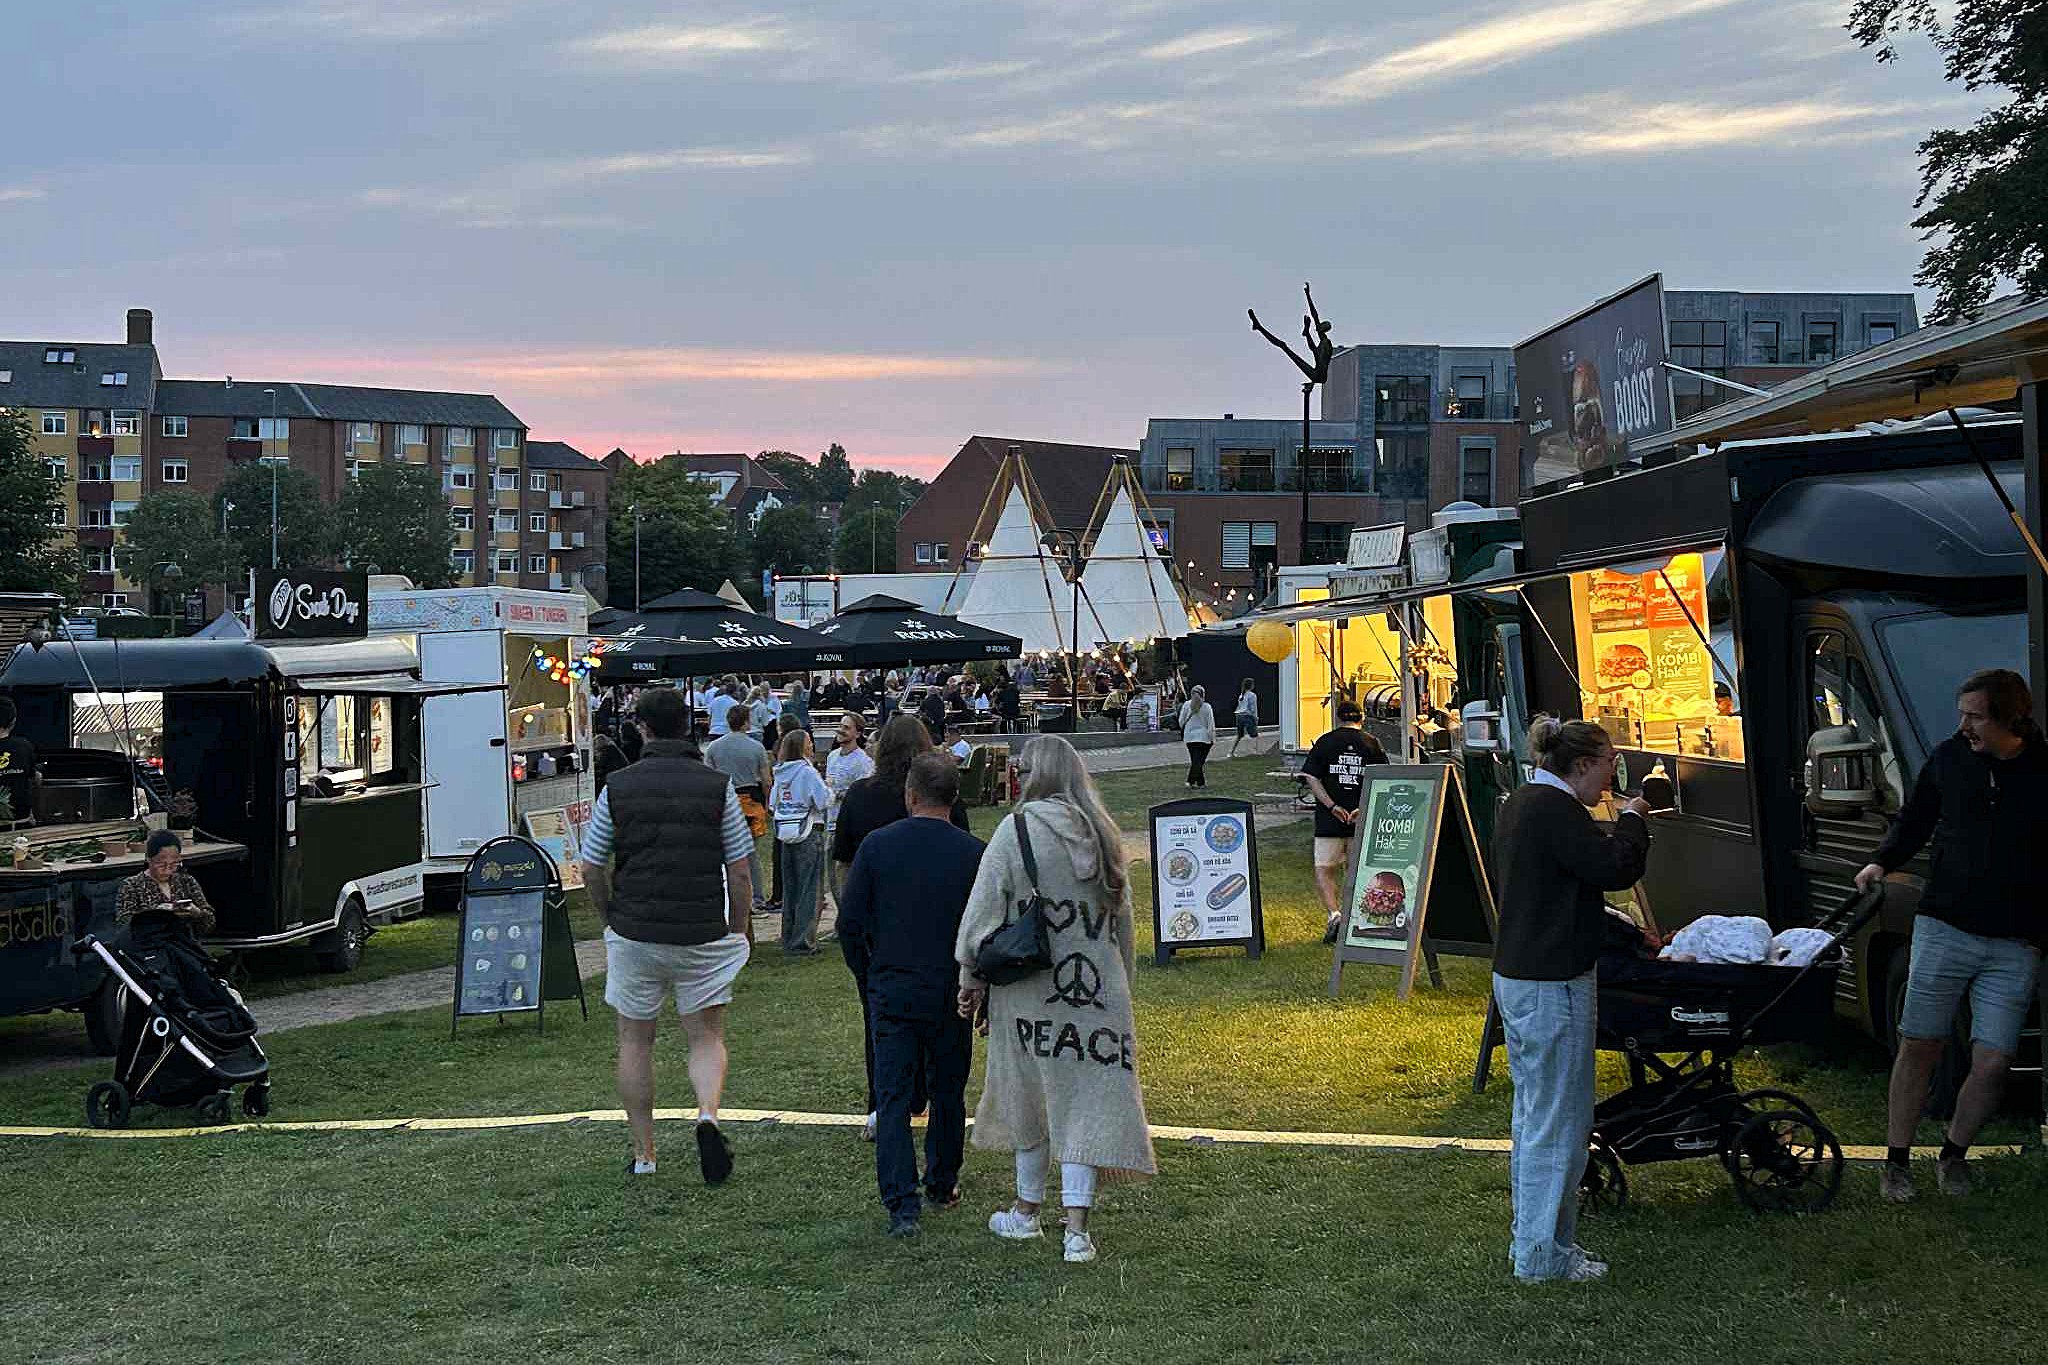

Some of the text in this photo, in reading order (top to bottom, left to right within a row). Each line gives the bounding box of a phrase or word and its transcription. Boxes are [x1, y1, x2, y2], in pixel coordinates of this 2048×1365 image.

[711, 634, 792, 648] ROYAL
[893, 630, 965, 640] ROYAL
[823, 653, 844, 662] ROYAL
[1656, 652, 1702, 667] KOMBI
[639, 662, 657, 671] ROYAL
[1657, 666, 1681, 679] Hak
[1377, 818, 1416, 834] KOMBI
[1375, 834, 1394, 850] Hak
